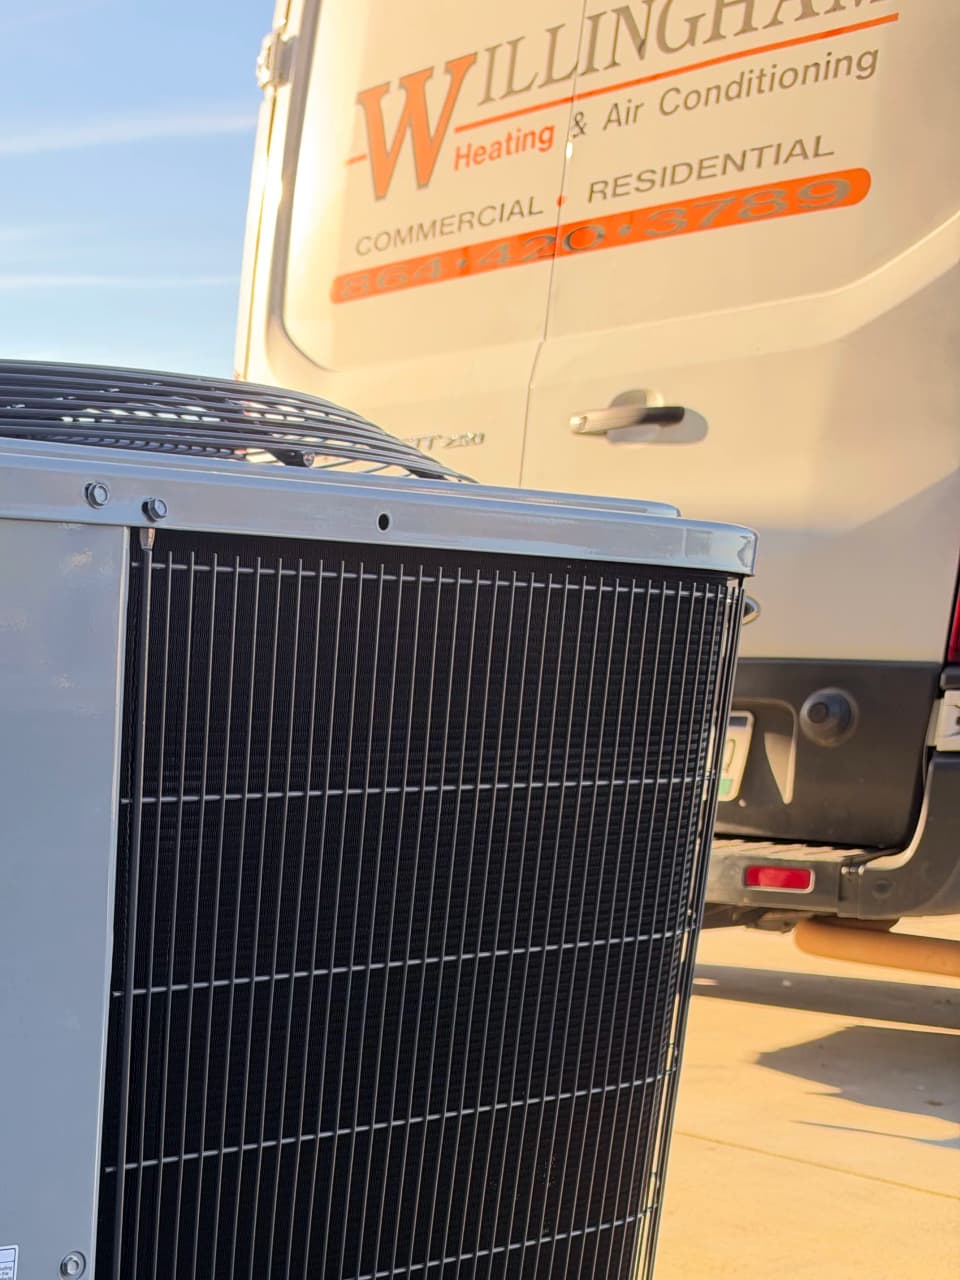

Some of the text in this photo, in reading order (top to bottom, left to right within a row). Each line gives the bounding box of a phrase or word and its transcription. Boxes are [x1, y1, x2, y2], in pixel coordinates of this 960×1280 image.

[357, 0, 886, 200] WILLINGH
[453, 48, 880, 172] Heating & Air Conditioning
[354, 135, 836, 257] COMMERCIAL RESIDENTIAL
